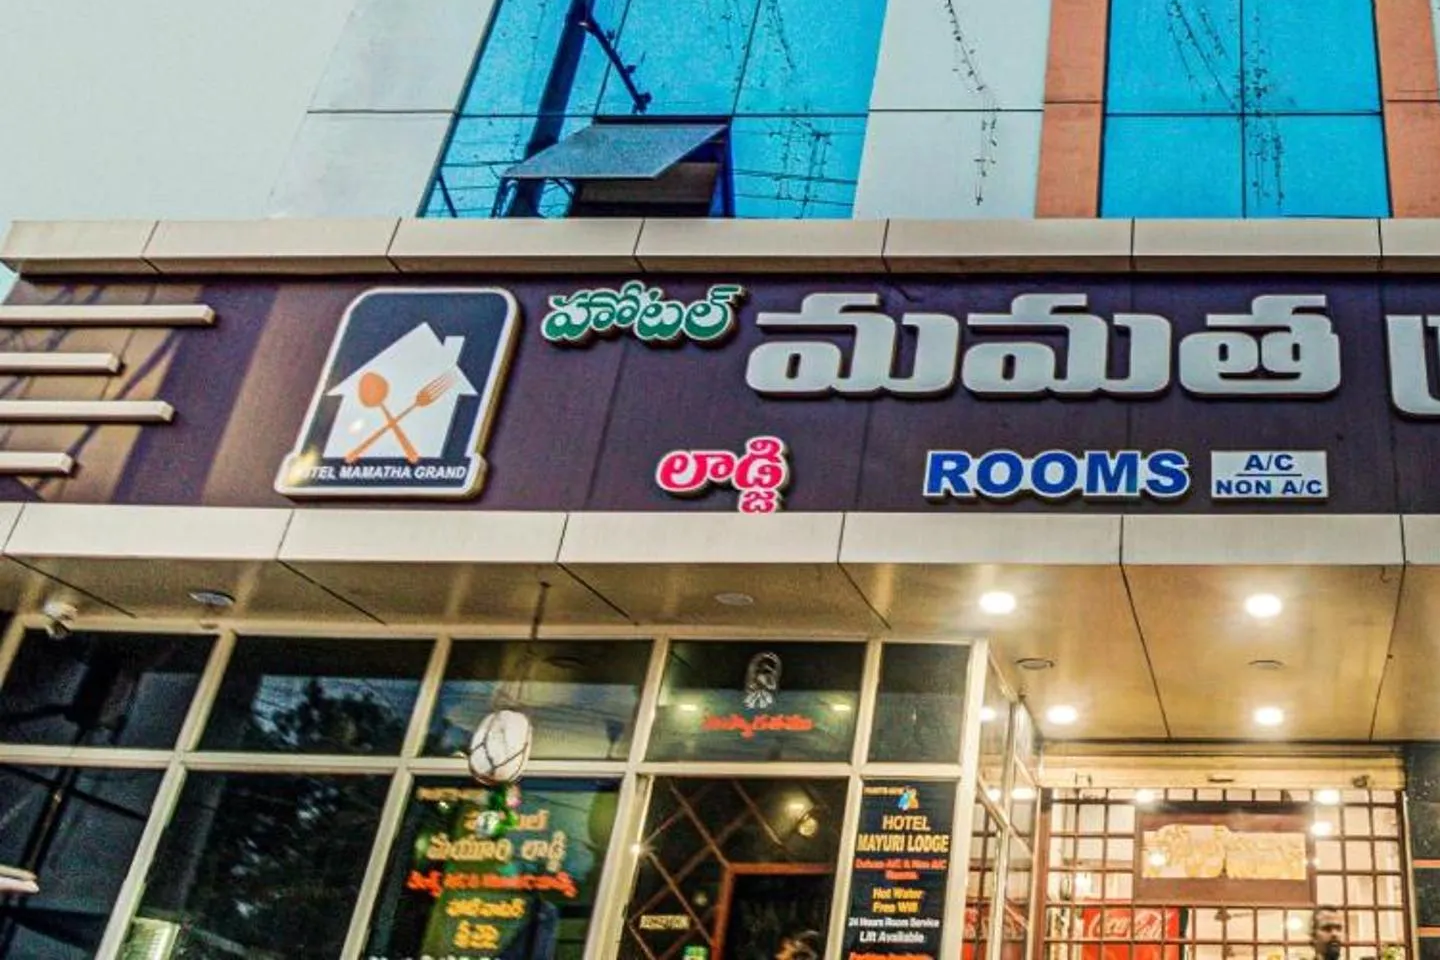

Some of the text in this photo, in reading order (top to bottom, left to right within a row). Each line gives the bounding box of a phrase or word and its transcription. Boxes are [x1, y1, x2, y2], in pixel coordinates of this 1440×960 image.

[541, 280, 743, 341] హోటల్
[745, 293, 1341, 397] మమత
[1244, 453, 1295, 472] A/C
[339, 465, 412, 480] MAMATHA
[414, 465, 467, 480] GRAND
[924, 448, 1191, 499] ROOMS
[1216, 480, 1323, 495] NON A/C
[882, 814, 932, 831] HOTEL
[857, 834, 950, 853] MAYURI LODGE
